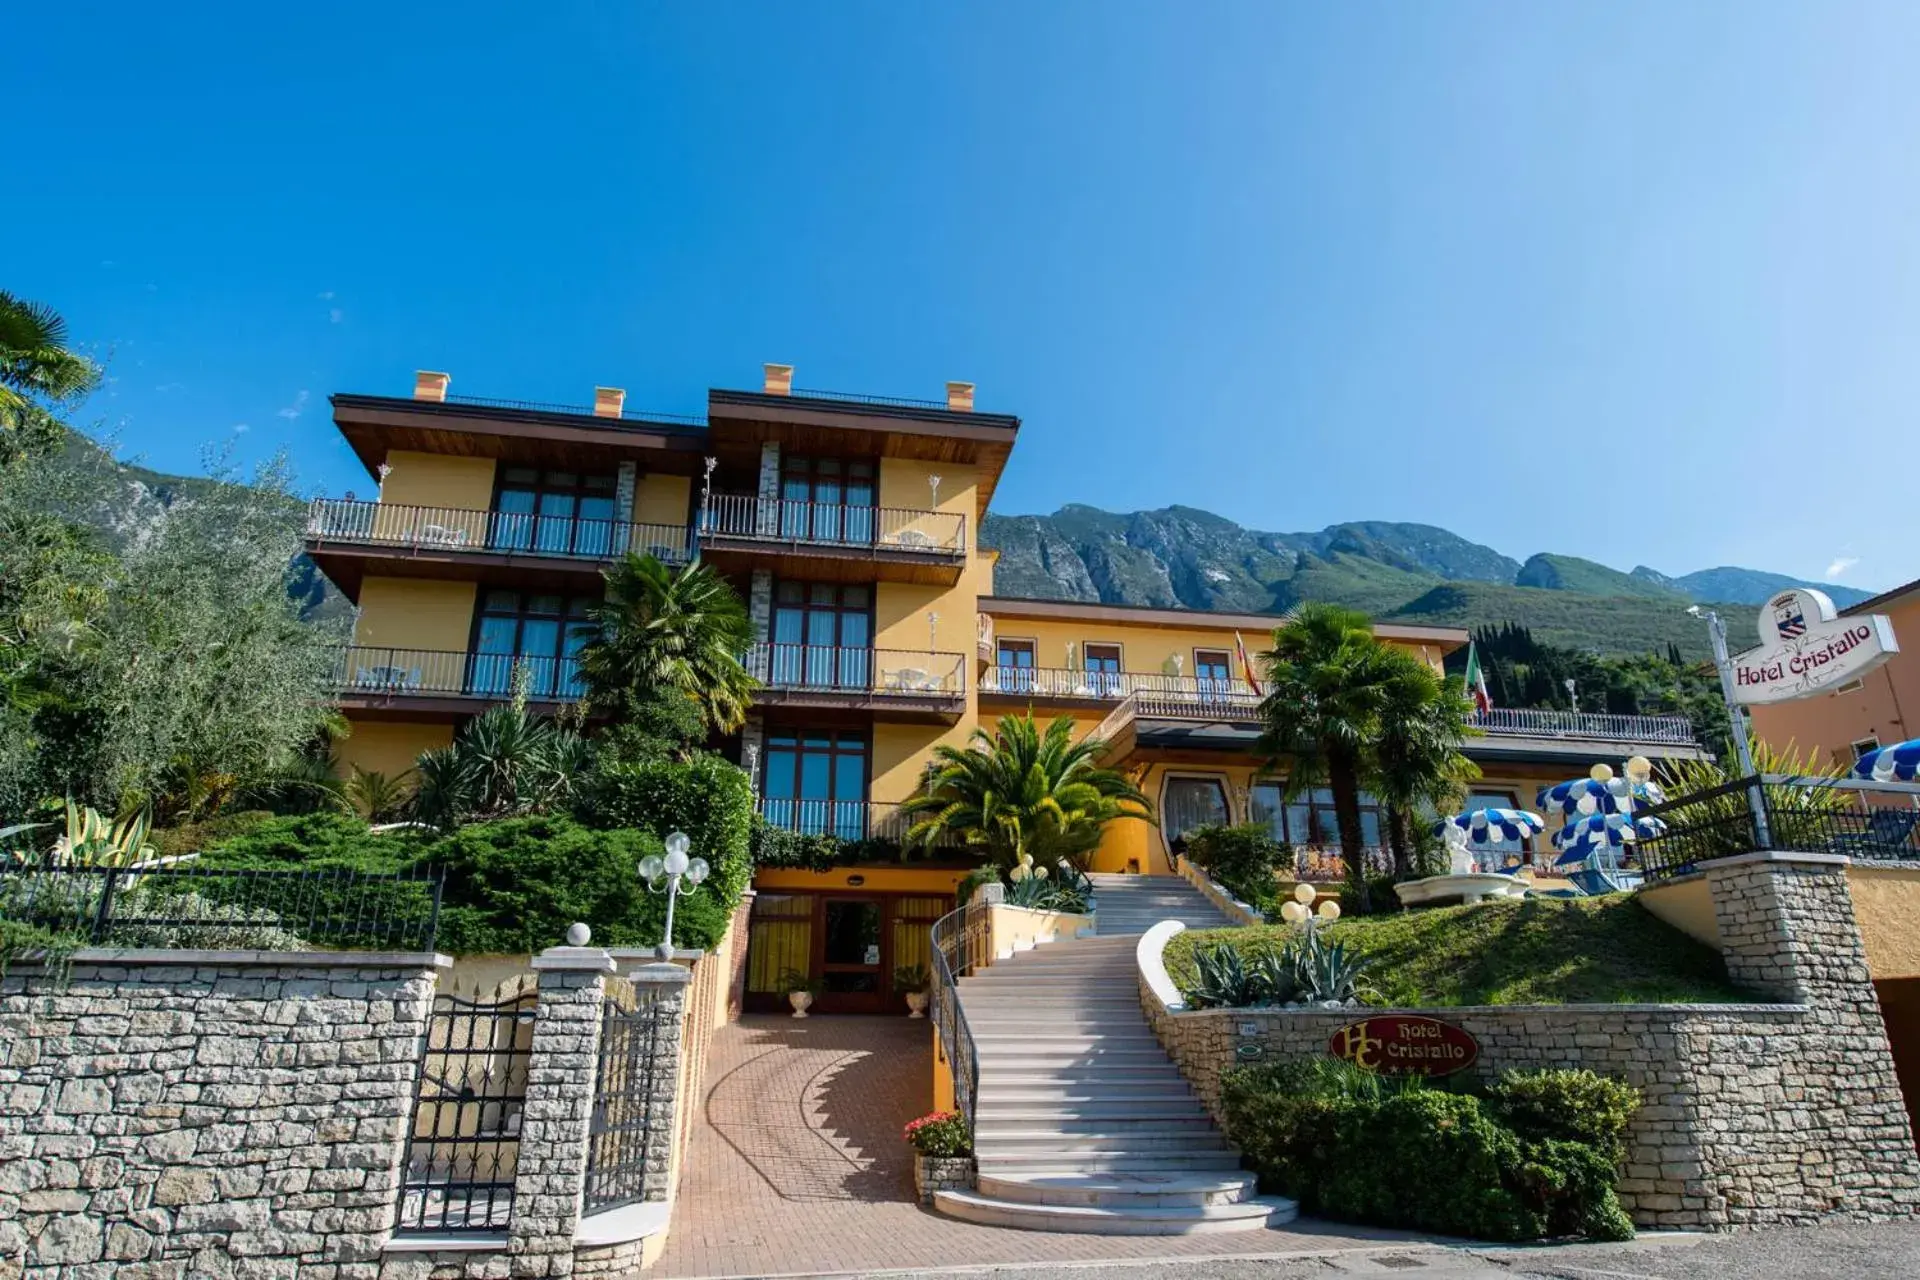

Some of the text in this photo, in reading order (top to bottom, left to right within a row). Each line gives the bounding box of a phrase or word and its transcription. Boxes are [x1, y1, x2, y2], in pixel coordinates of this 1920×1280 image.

[1737, 625, 1870, 686] Hotel Cristallo
[1387, 1043, 1465, 1058] Cristallo
